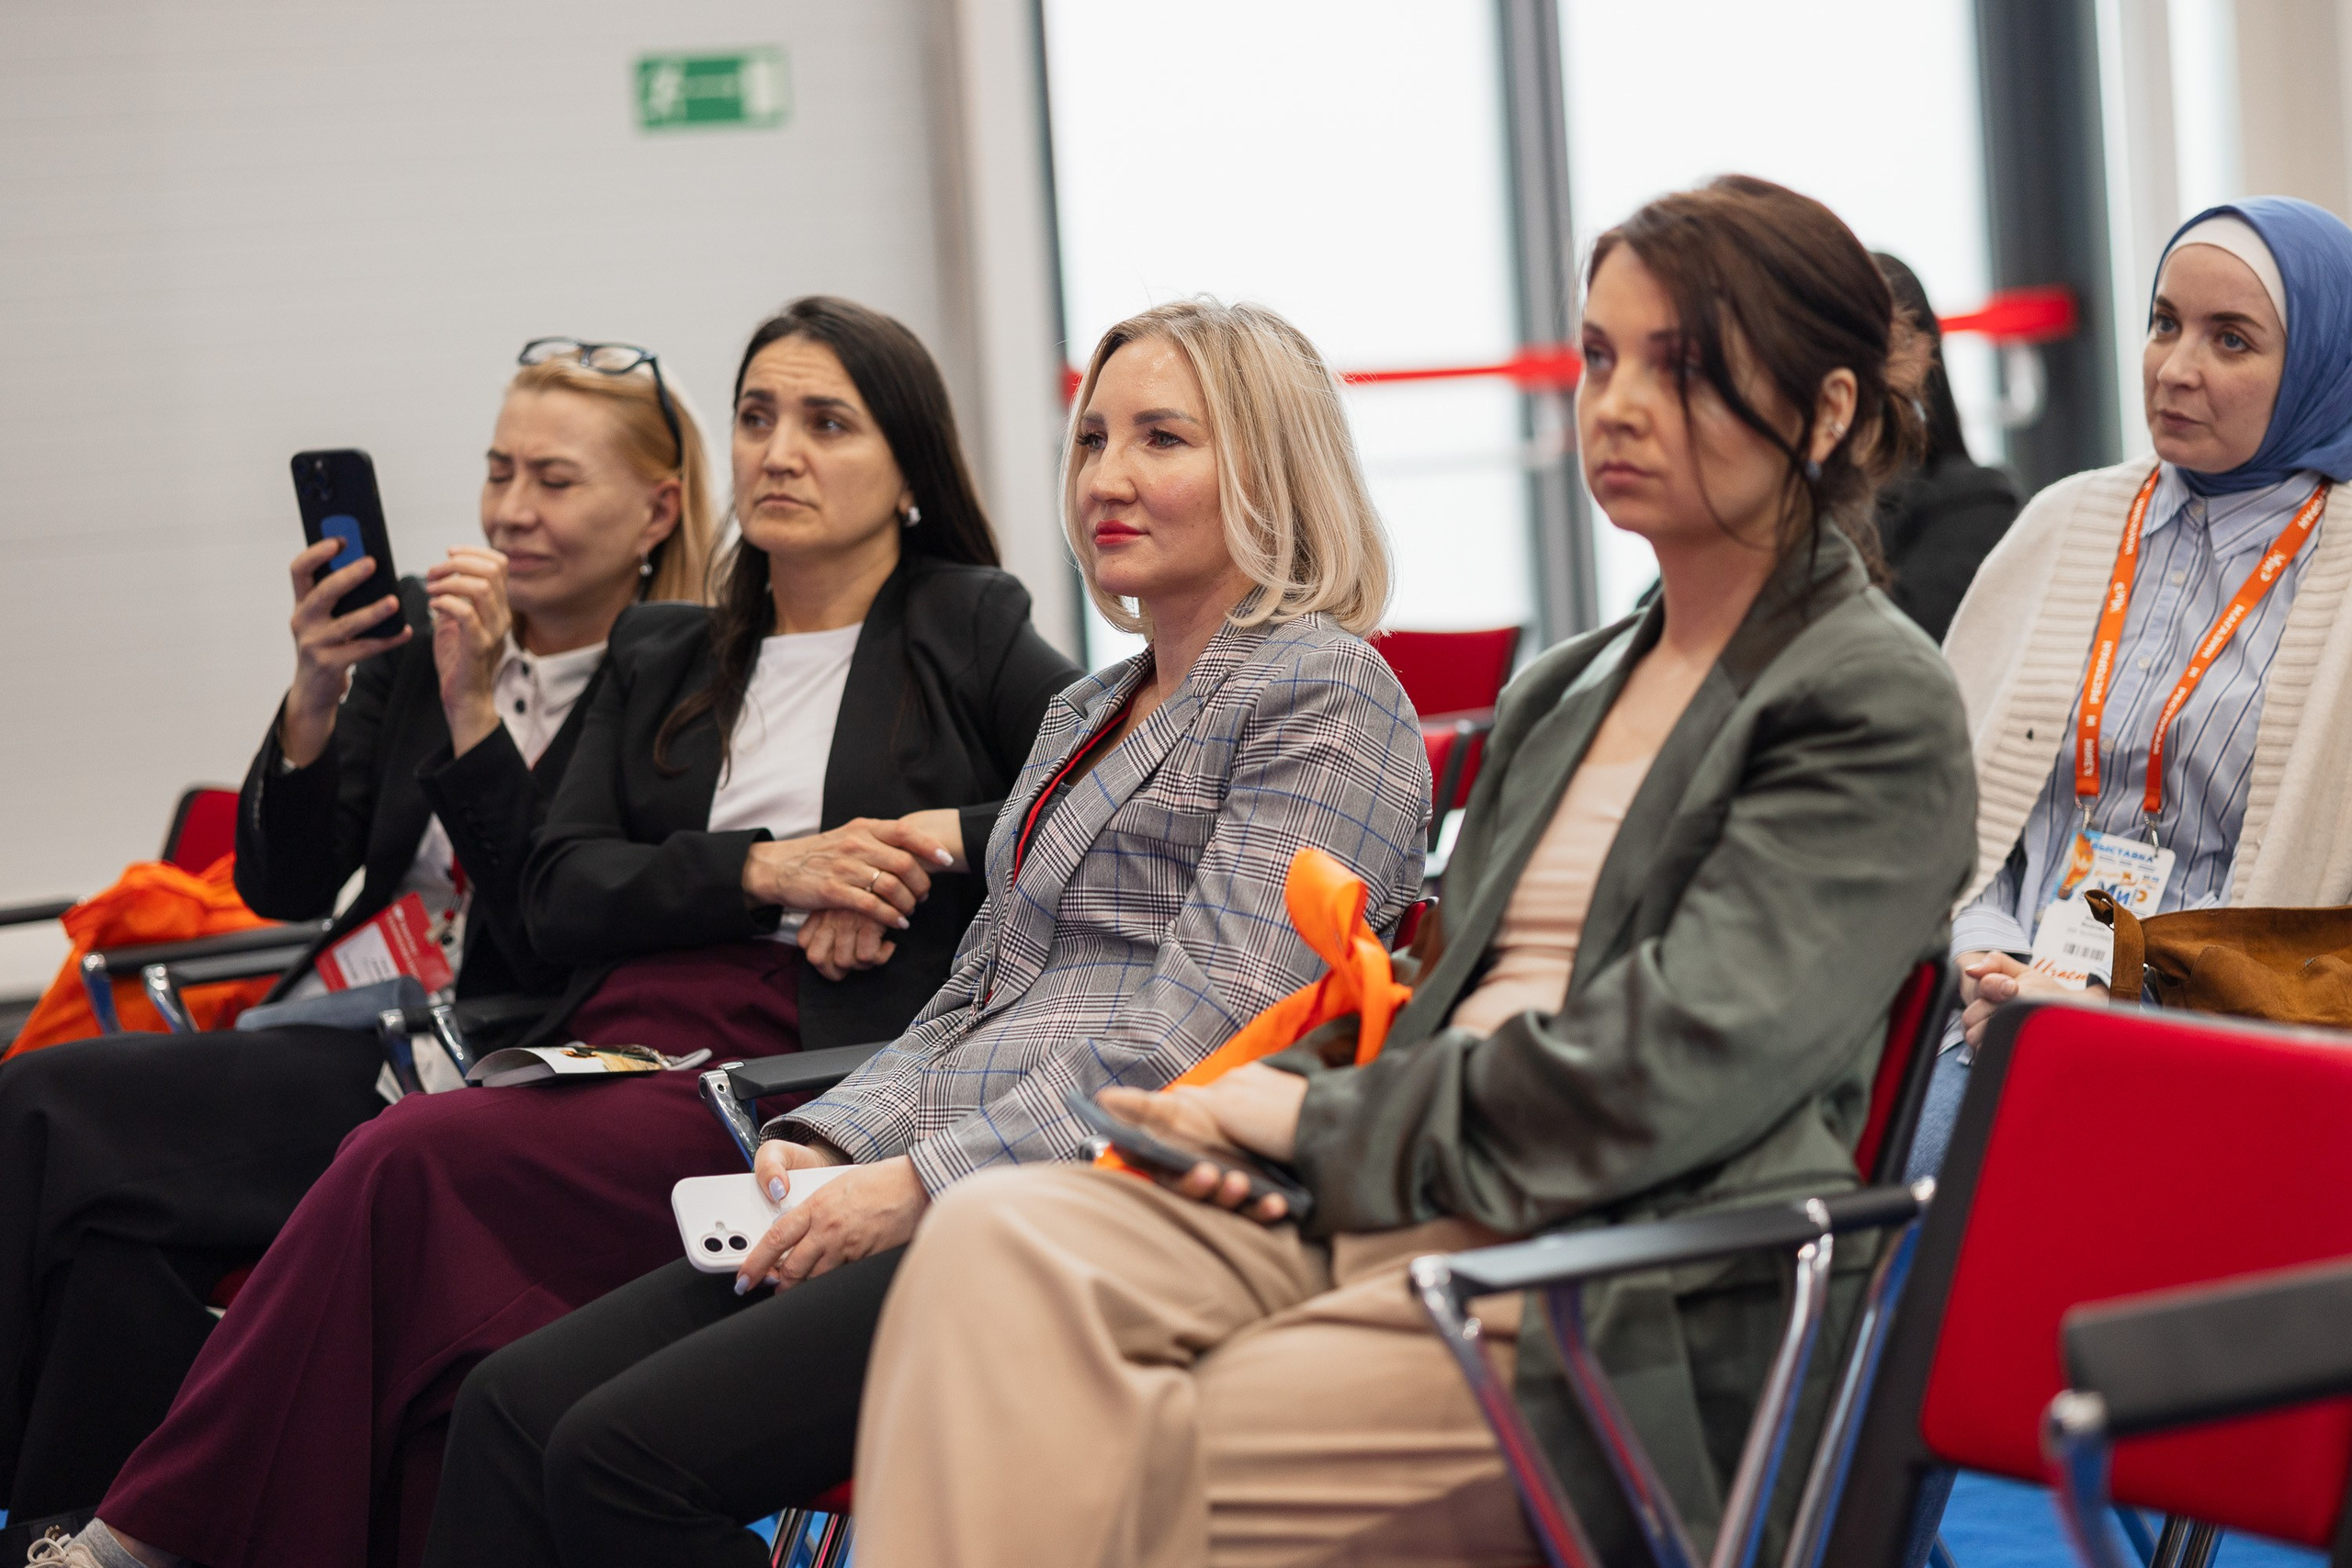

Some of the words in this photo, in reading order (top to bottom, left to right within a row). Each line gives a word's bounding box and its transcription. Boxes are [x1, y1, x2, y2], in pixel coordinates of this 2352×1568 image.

[2201, 604, 2245, 659] МАГАЗИН
[2088, 640, 2113, 705] РЕСТОРАН
[2092, 842, 2154, 863] ВЫСТАВКА
